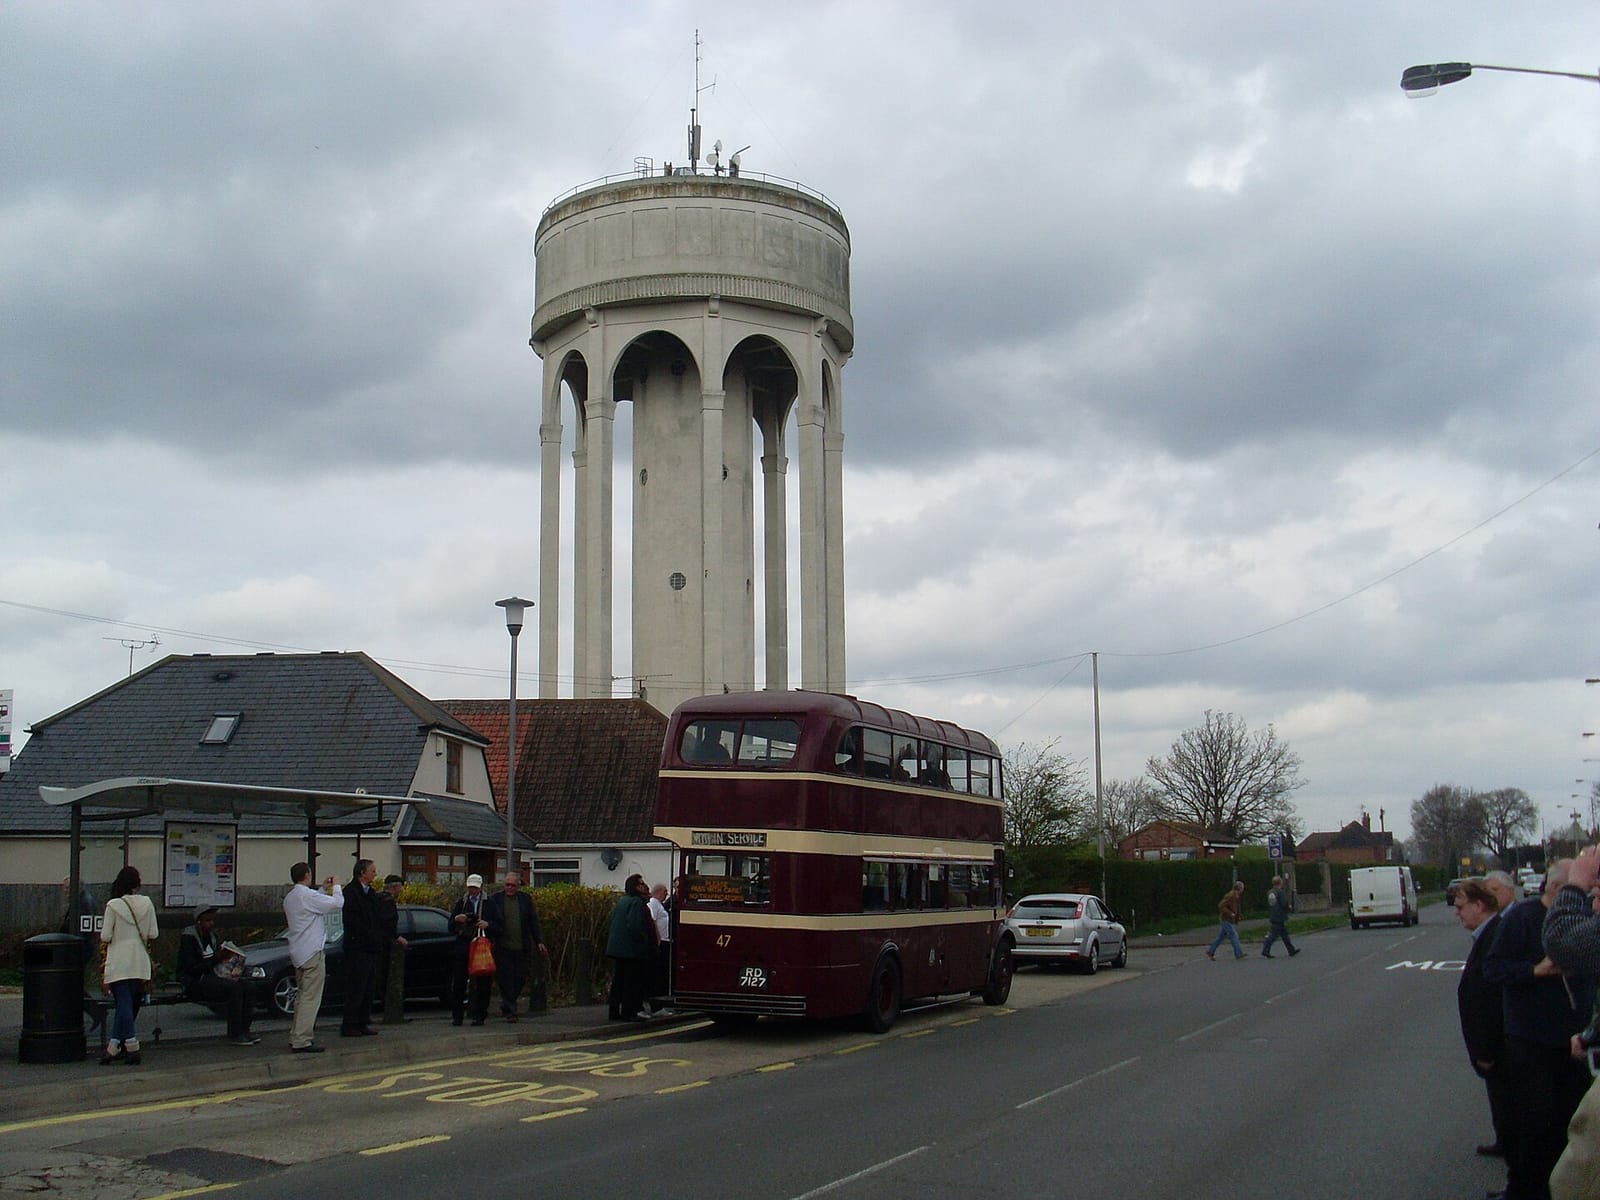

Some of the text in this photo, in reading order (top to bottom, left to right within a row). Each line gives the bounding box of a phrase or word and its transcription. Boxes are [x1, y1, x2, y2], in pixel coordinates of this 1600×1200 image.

[727, 833, 764, 846] SERVICE
[716, 934, 731, 947] 47
[745, 967, 763, 977] RD
[740, 976, 767, 987] 7127
[489, 1050, 694, 1078] BUS
[323, 1072, 600, 1108] STOP
